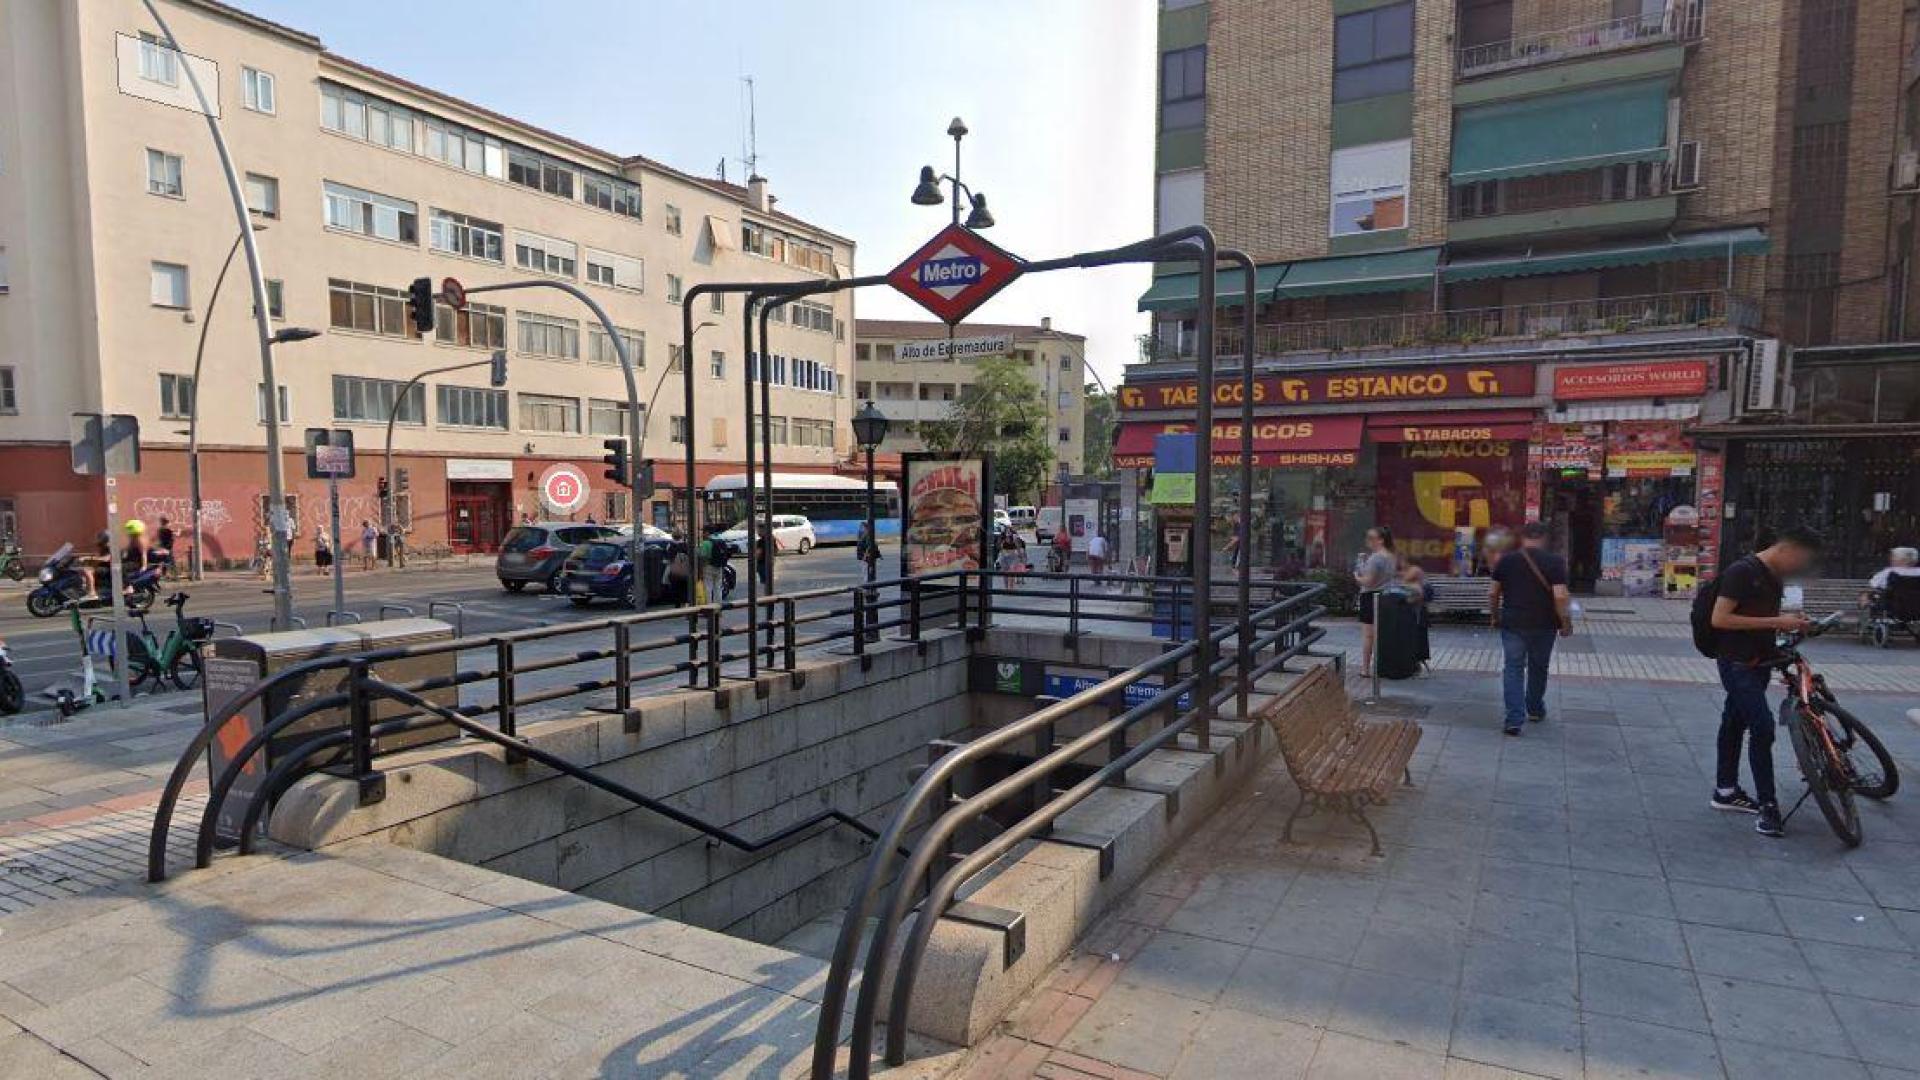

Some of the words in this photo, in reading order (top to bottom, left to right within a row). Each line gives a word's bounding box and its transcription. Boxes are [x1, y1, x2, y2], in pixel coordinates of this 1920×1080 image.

[923, 262, 977, 281] Metro
[902, 346, 920, 359] Alto
[922, 344, 936, 357] de
[938, 340, 1004, 356] Extremadura
[1160, 382, 1264, 405] TABCOS
[1327, 374, 1447, 398] ESTANCO
[1423, 427, 1491, 441] TABACOS
[1280, 453, 1355, 465] SHISHAS
